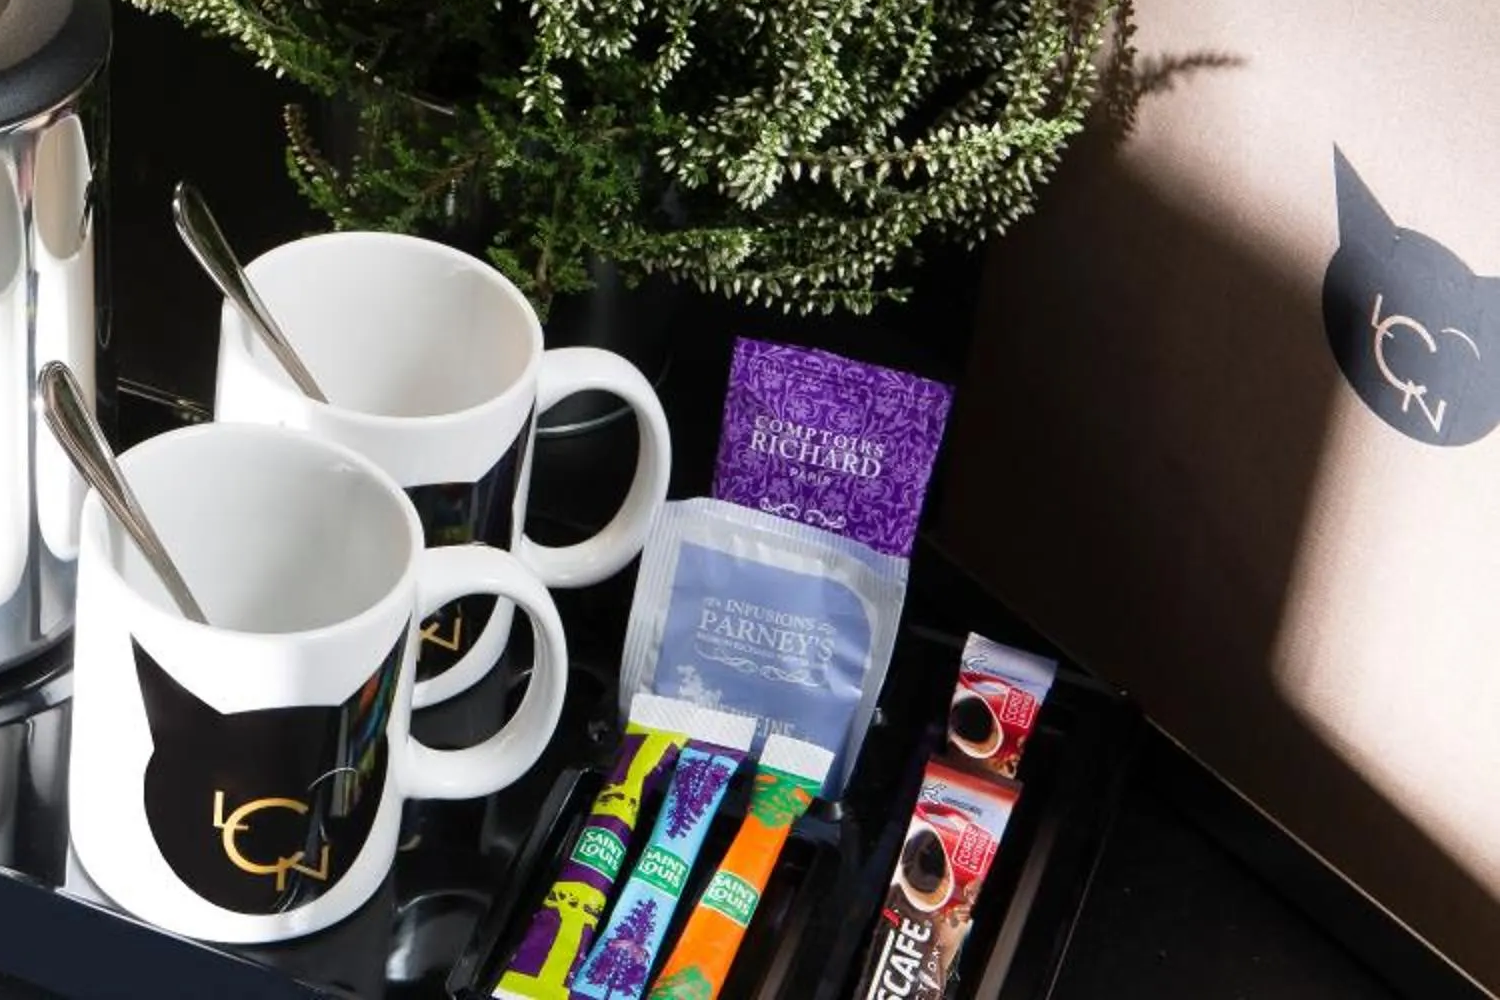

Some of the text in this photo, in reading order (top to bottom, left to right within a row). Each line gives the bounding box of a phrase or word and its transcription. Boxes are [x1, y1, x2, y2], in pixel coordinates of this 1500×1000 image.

[755, 415, 885, 458] COMPTOIRS
[750, 429, 881, 479] RICHARD
[725, 599, 815, 631] INFUSIONS
[699, 608, 835, 662] PARNEY'S
[579, 842, 619, 871] LOUIS
[586, 831, 623, 859] SAINT
[638, 860, 682, 888] LOUIS
[713, 872, 755, 903] SAINT
[707, 885, 749, 916] LOUIS
